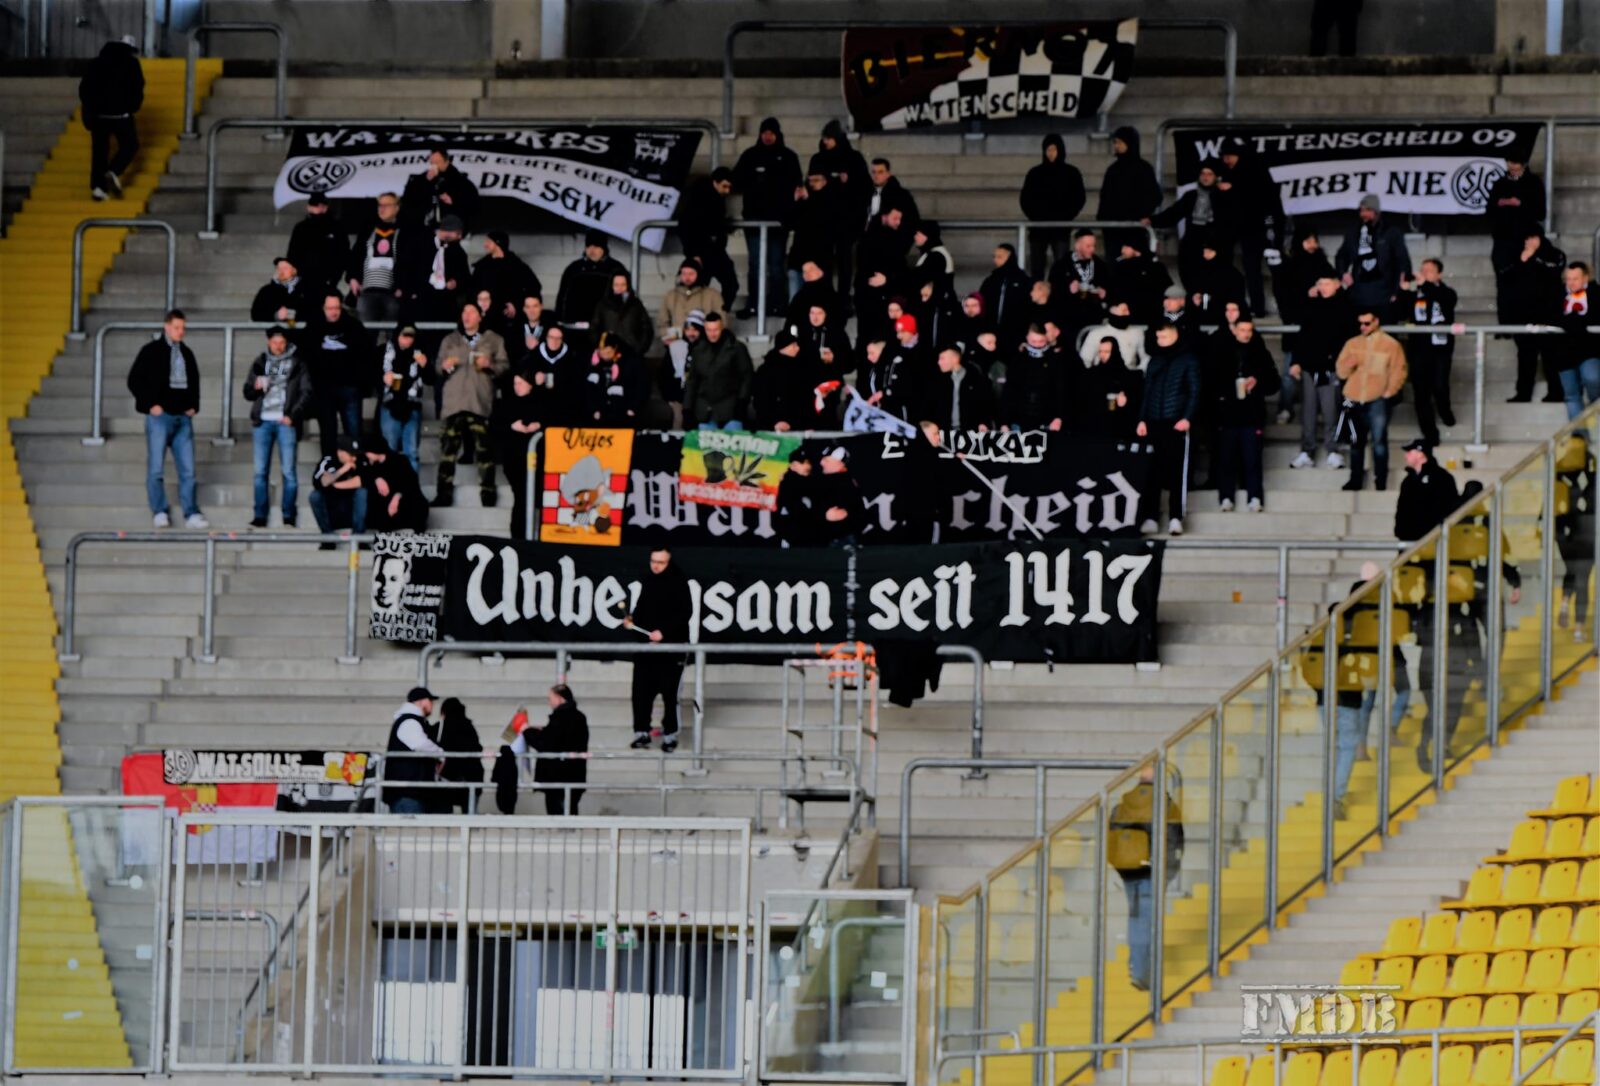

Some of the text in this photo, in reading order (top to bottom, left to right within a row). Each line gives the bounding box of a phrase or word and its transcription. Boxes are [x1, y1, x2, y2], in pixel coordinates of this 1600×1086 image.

[903, 90, 1079, 123] WATTENSCHEID
[1471, 129, 1517, 149] 09
[360, 158, 386, 169] 90
[391, 153, 488, 166] MINTEN
[494, 156, 568, 174] ECHTE
[573, 168, 673, 209] GEFÜHLE
[1385, 171, 1446, 195] NIE
[479, 172, 615, 221] DIE SGW
[375, 538, 449, 557] JUSTIN
[867, 560, 977, 632] seit
[999, 548, 1153, 628] 1417
[371, 625, 436, 641] FRIEDEN
